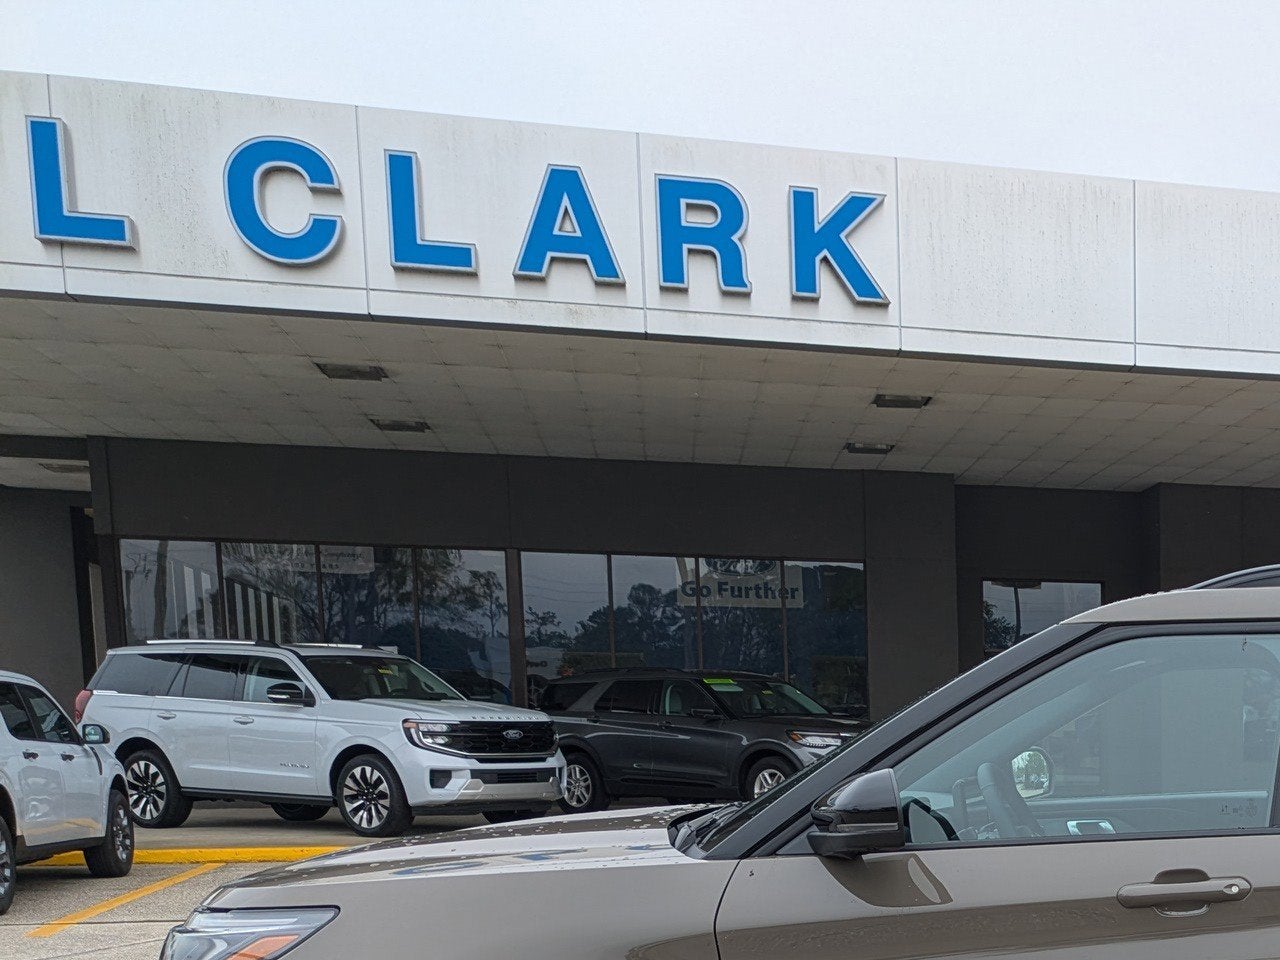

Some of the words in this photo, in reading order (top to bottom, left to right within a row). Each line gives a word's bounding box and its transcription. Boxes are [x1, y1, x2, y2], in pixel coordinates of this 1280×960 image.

[25, 115, 136, 251] L
[223, 134, 891, 306] CLARK
[681, 580, 712, 598] Go
[717, 581, 799, 600] Further
